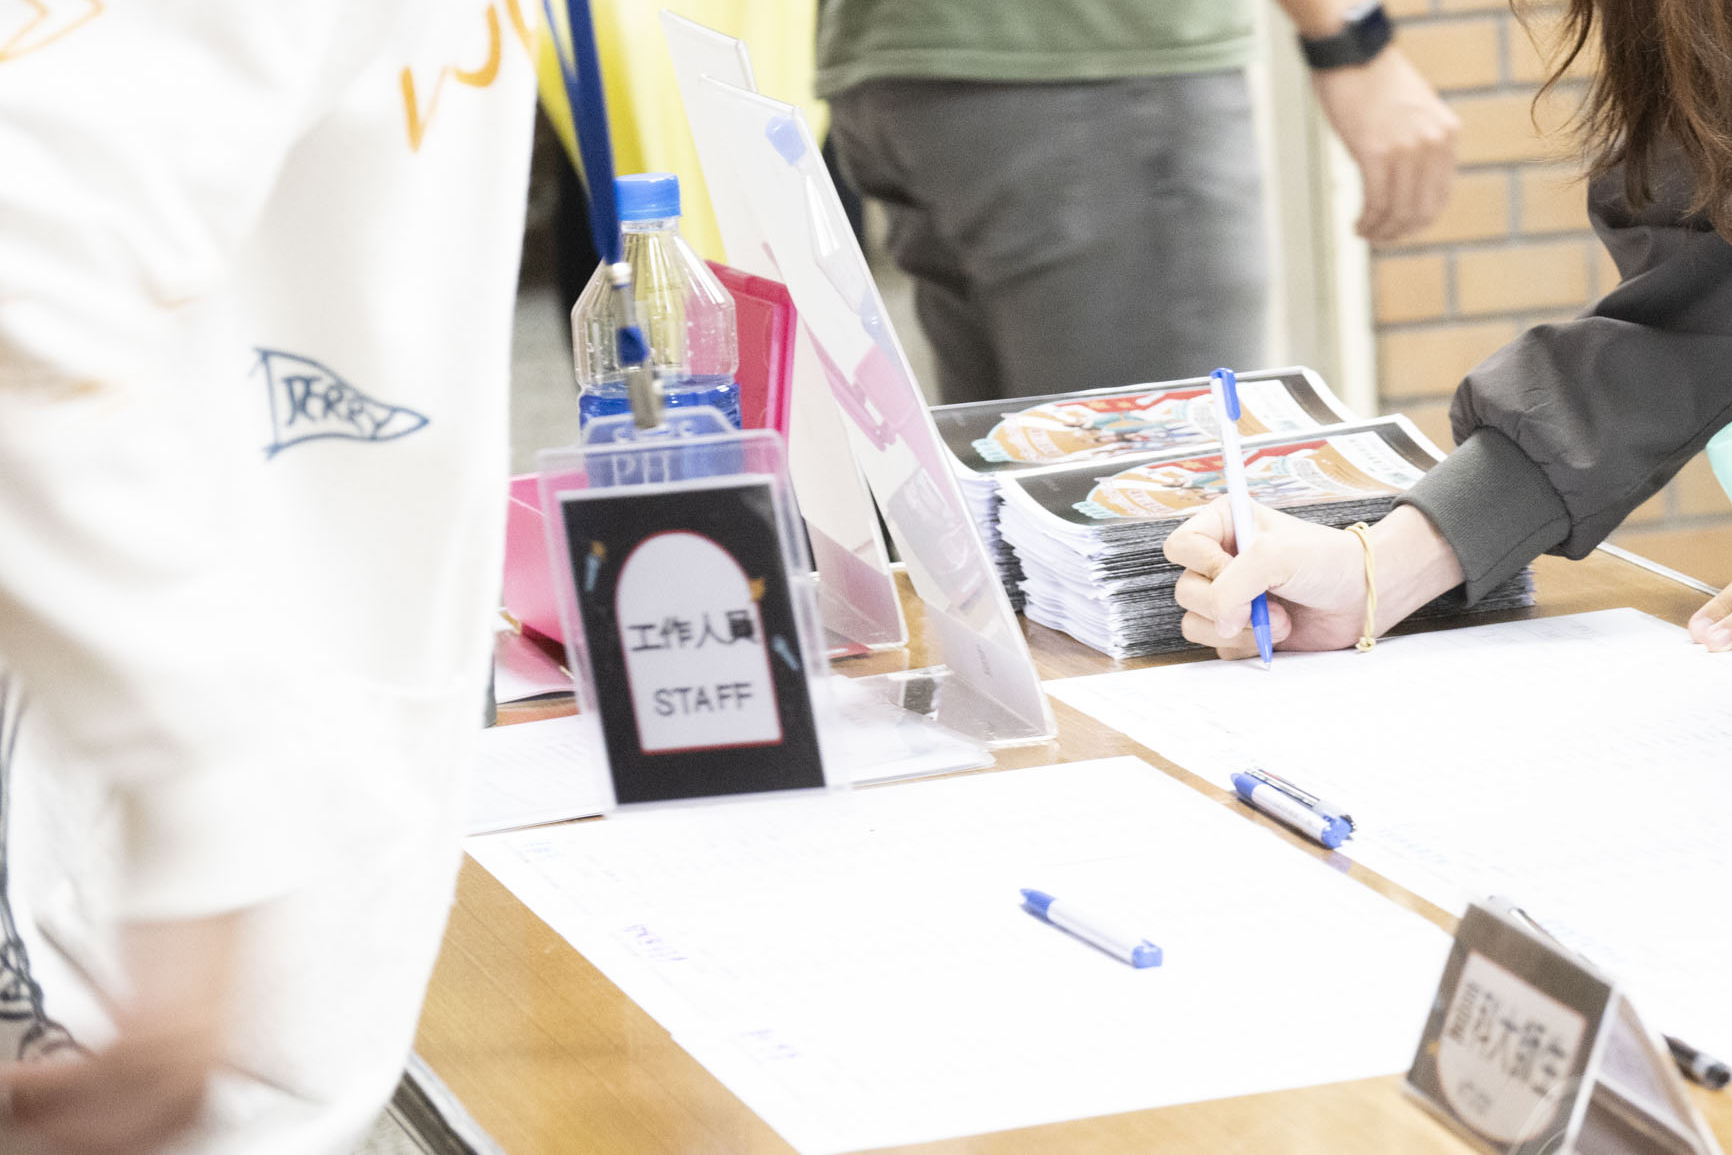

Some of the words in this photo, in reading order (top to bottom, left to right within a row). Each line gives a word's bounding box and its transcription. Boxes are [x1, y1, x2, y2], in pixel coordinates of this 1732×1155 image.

[625, 608, 760, 652] 工作人員
[653, 681, 755, 717] STAFF
